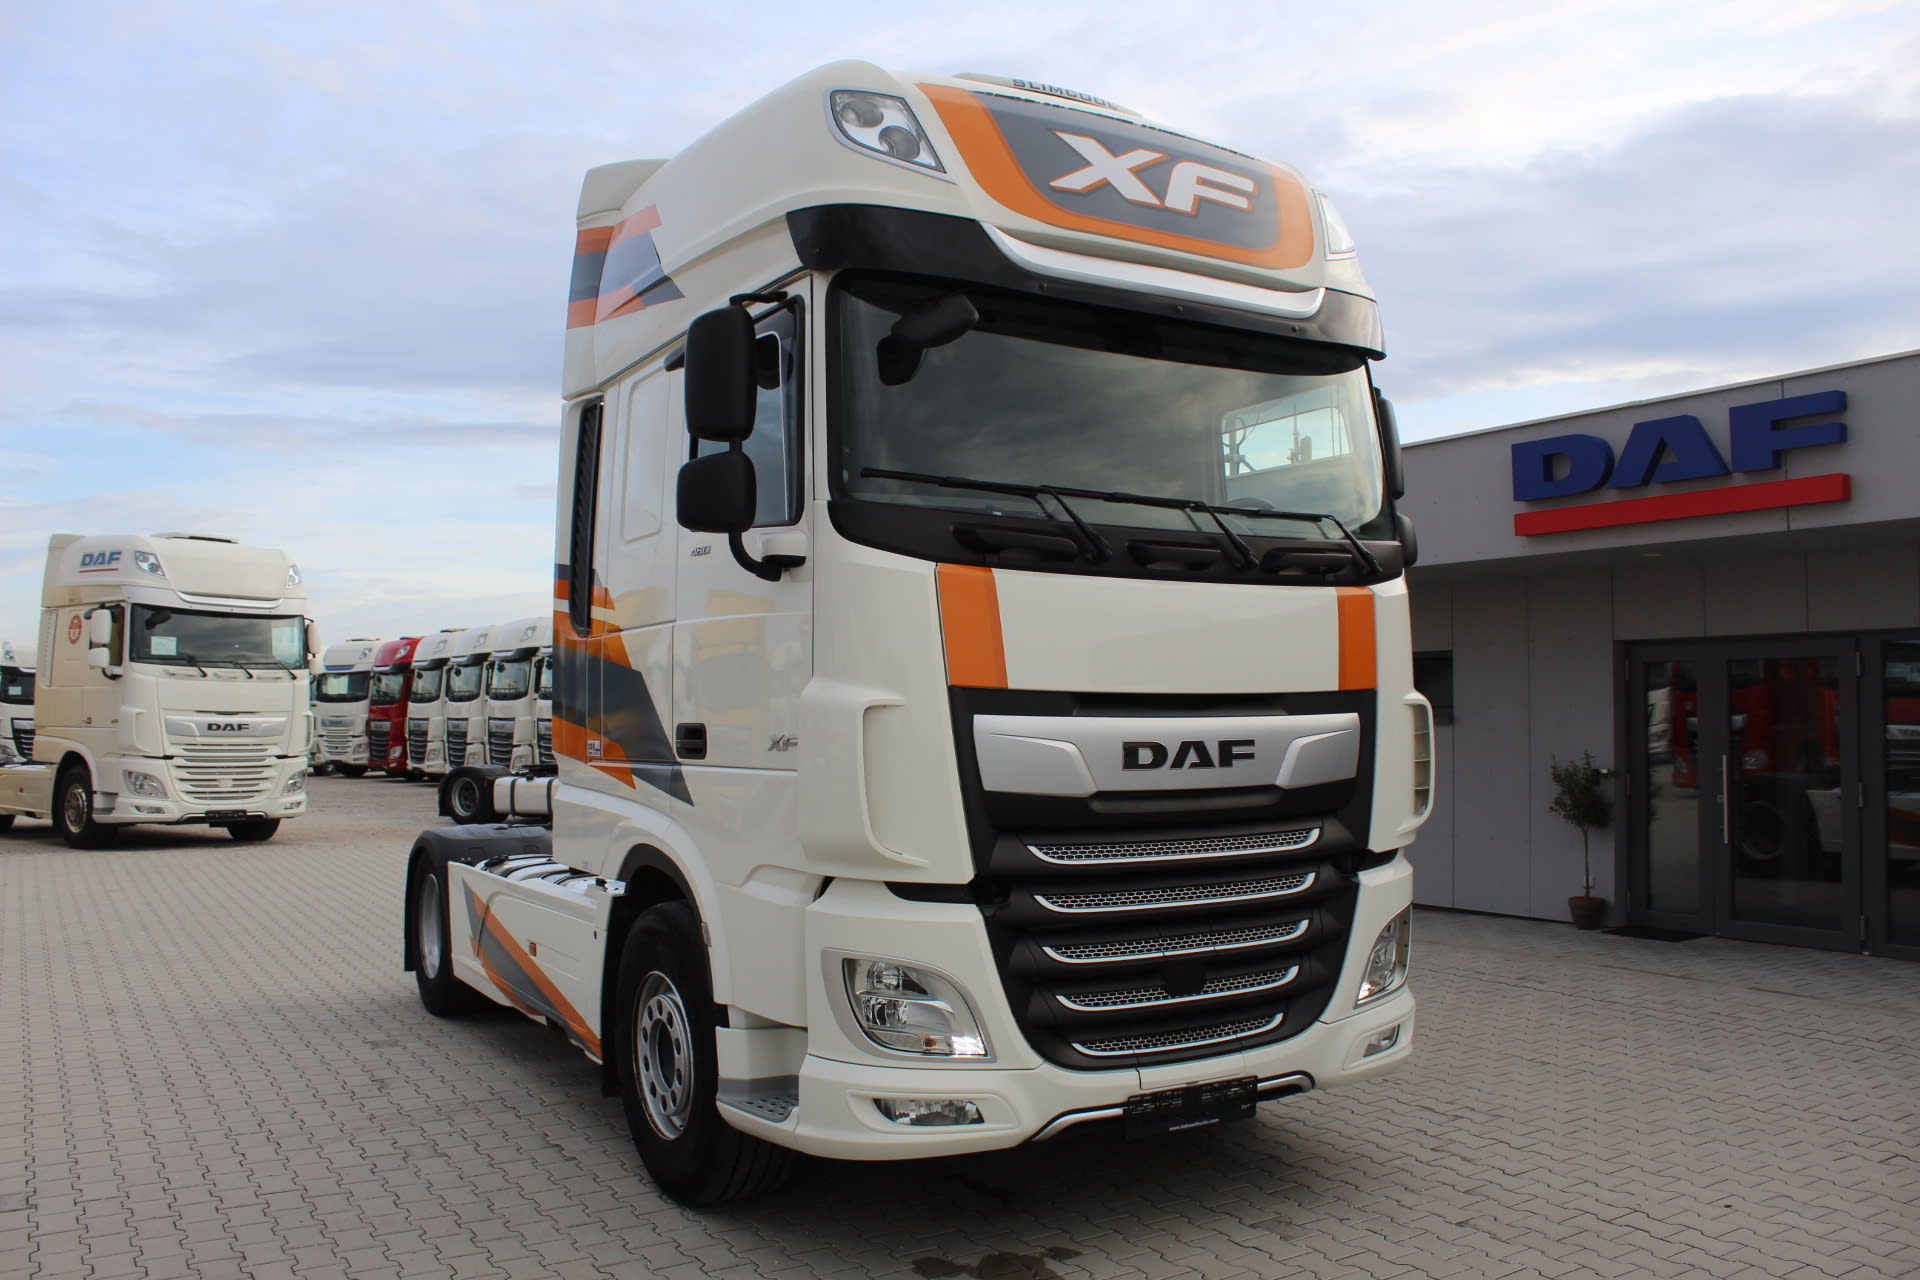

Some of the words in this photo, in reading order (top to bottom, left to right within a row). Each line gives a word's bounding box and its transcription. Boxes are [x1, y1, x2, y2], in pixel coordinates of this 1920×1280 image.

[1049, 130, 1257, 216] XF
[1511, 390, 1847, 502] DAF
[80, 551, 122, 567] DAF
[207, 723, 249, 731] DAF
[768, 734, 799, 752] XF
[1122, 739, 1255, 771] DAF
